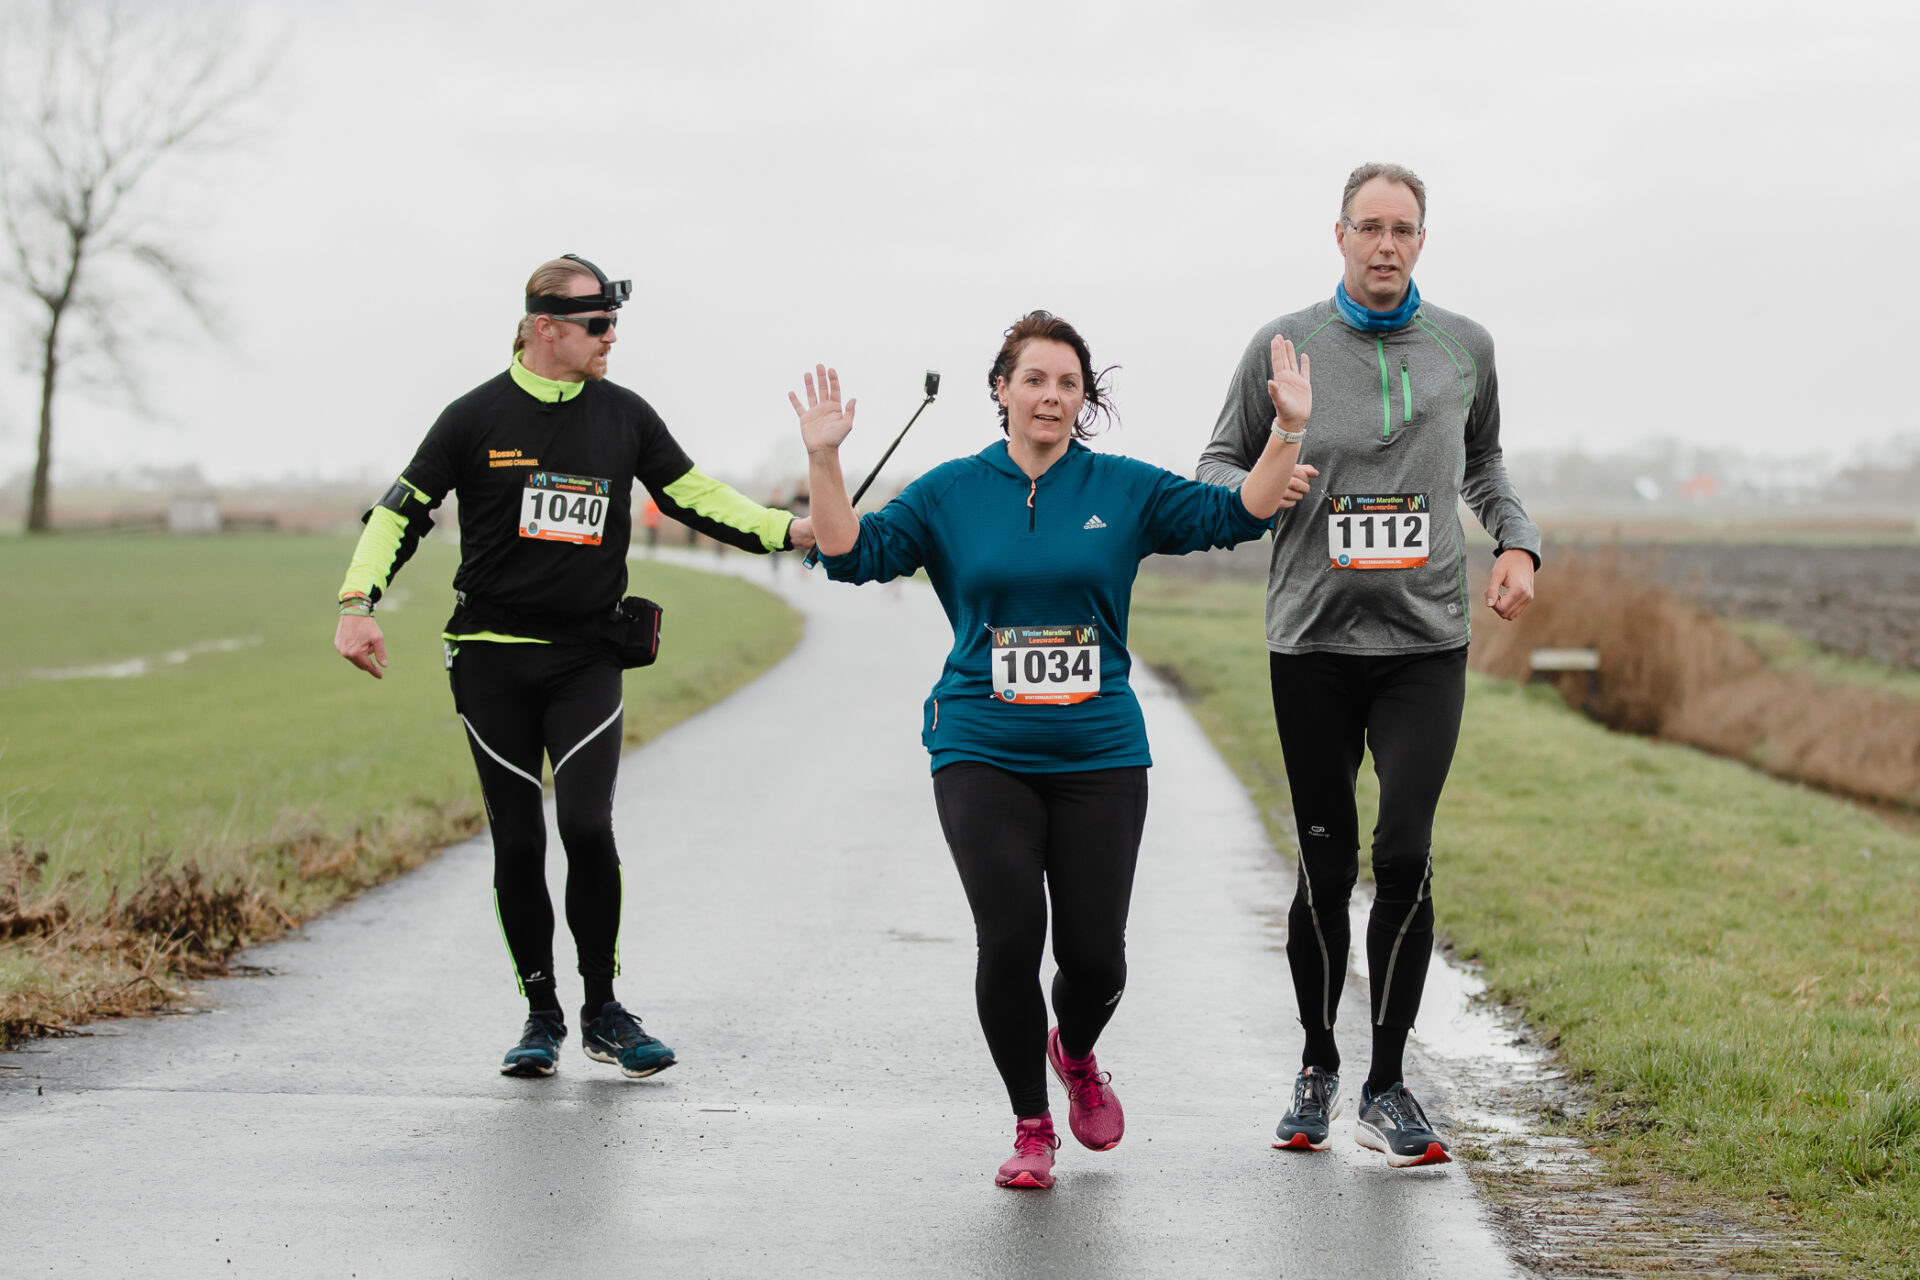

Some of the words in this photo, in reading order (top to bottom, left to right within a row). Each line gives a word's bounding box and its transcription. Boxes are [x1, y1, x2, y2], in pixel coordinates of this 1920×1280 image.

[530, 491, 602, 527] 1040
[1336, 516, 1422, 548] 1112
[1001, 649, 1092, 683] 1034
